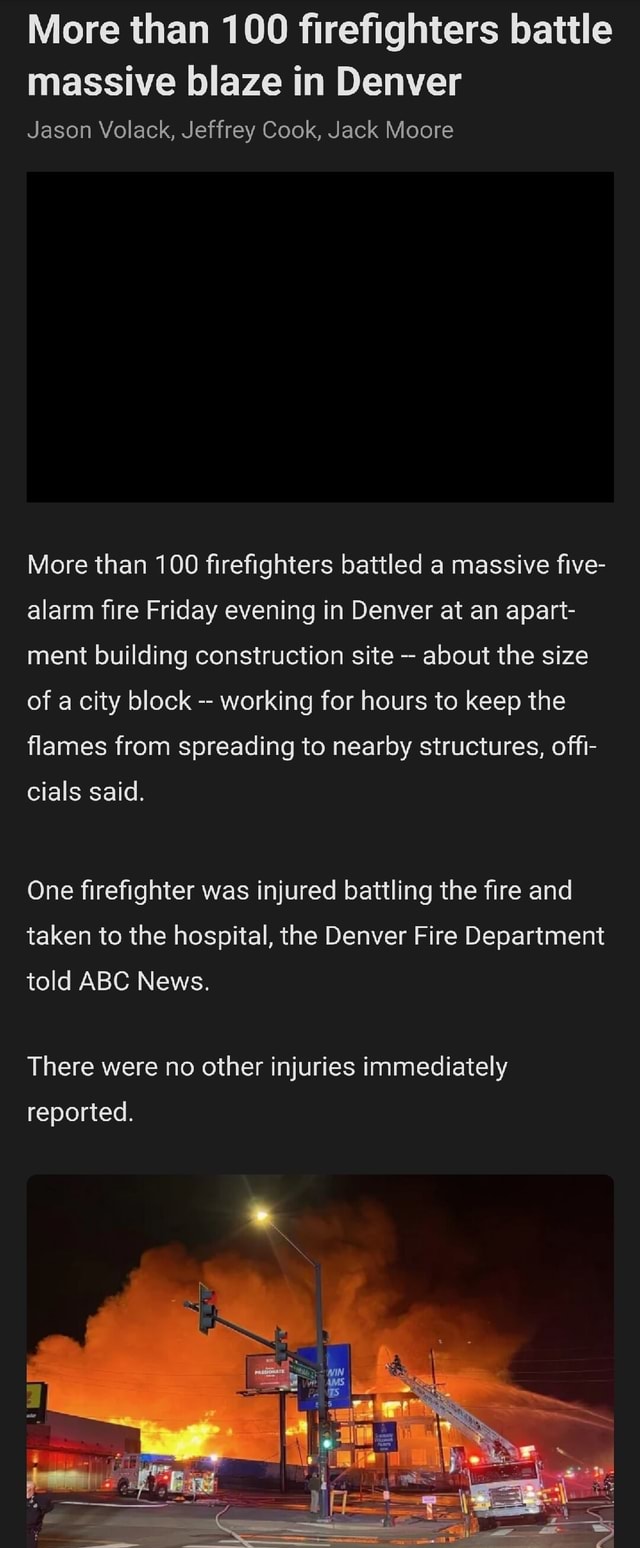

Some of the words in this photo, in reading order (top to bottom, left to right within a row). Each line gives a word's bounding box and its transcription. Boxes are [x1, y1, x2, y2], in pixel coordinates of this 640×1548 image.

[28, 13, 121, 45] More
[129, 11, 209, 45] than
[222, 12, 288, 45] 100
[298, 11, 499, 53] firefighters
[510, 11, 613, 45] battle
[28, 64, 177, 97] massive
[187, 64, 283, 97] blaze
[293, 64, 325, 97] in
[337, 65, 463, 97] Denver
[26, 120, 92, 140] Jason
[98, 119, 175, 142] Volack,
[181, 119, 256, 144] Jeffrey
[262, 119, 322, 142] Cook,
[327, 119, 379, 140] Jack
[386, 120, 454, 139] Moore
[28, 553, 89, 575] More
[94, 552, 147, 575] than
[155, 553, 199, 575] 100
[205, 552, 334, 581] firefighters
[341, 552, 423, 575] battled
[430, 558, 444, 575] a
[452, 553, 550, 575] massive
[556, 552, 606, 575] five-
[27, 779, 82, 802] cials
[89, 779, 145, 802] said.
[27, 879, 74, 901] One
[80, 878, 196, 906] firefighter
[201, 884, 250, 901] was
[257, 878, 337, 906] injured
[344, 878, 433, 906] battling
[439, 878, 478, 901] the
[483, 878, 522, 901] fire
[528, 878, 572, 901] and
[25, 969, 72, 992] told
[78, 970, 130, 992] ABC
[137, 970, 210, 992] News.
[26, 1054, 95, 1077] There
[101, 1060, 159, 1077] were
[165, 1060, 195, 1077] no
[201, 1054, 264, 1077] other
[271, 1055, 356, 1082] injuries
[363, 1054, 509, 1082] immediately
[27, 1100, 134, 1128] reported.
